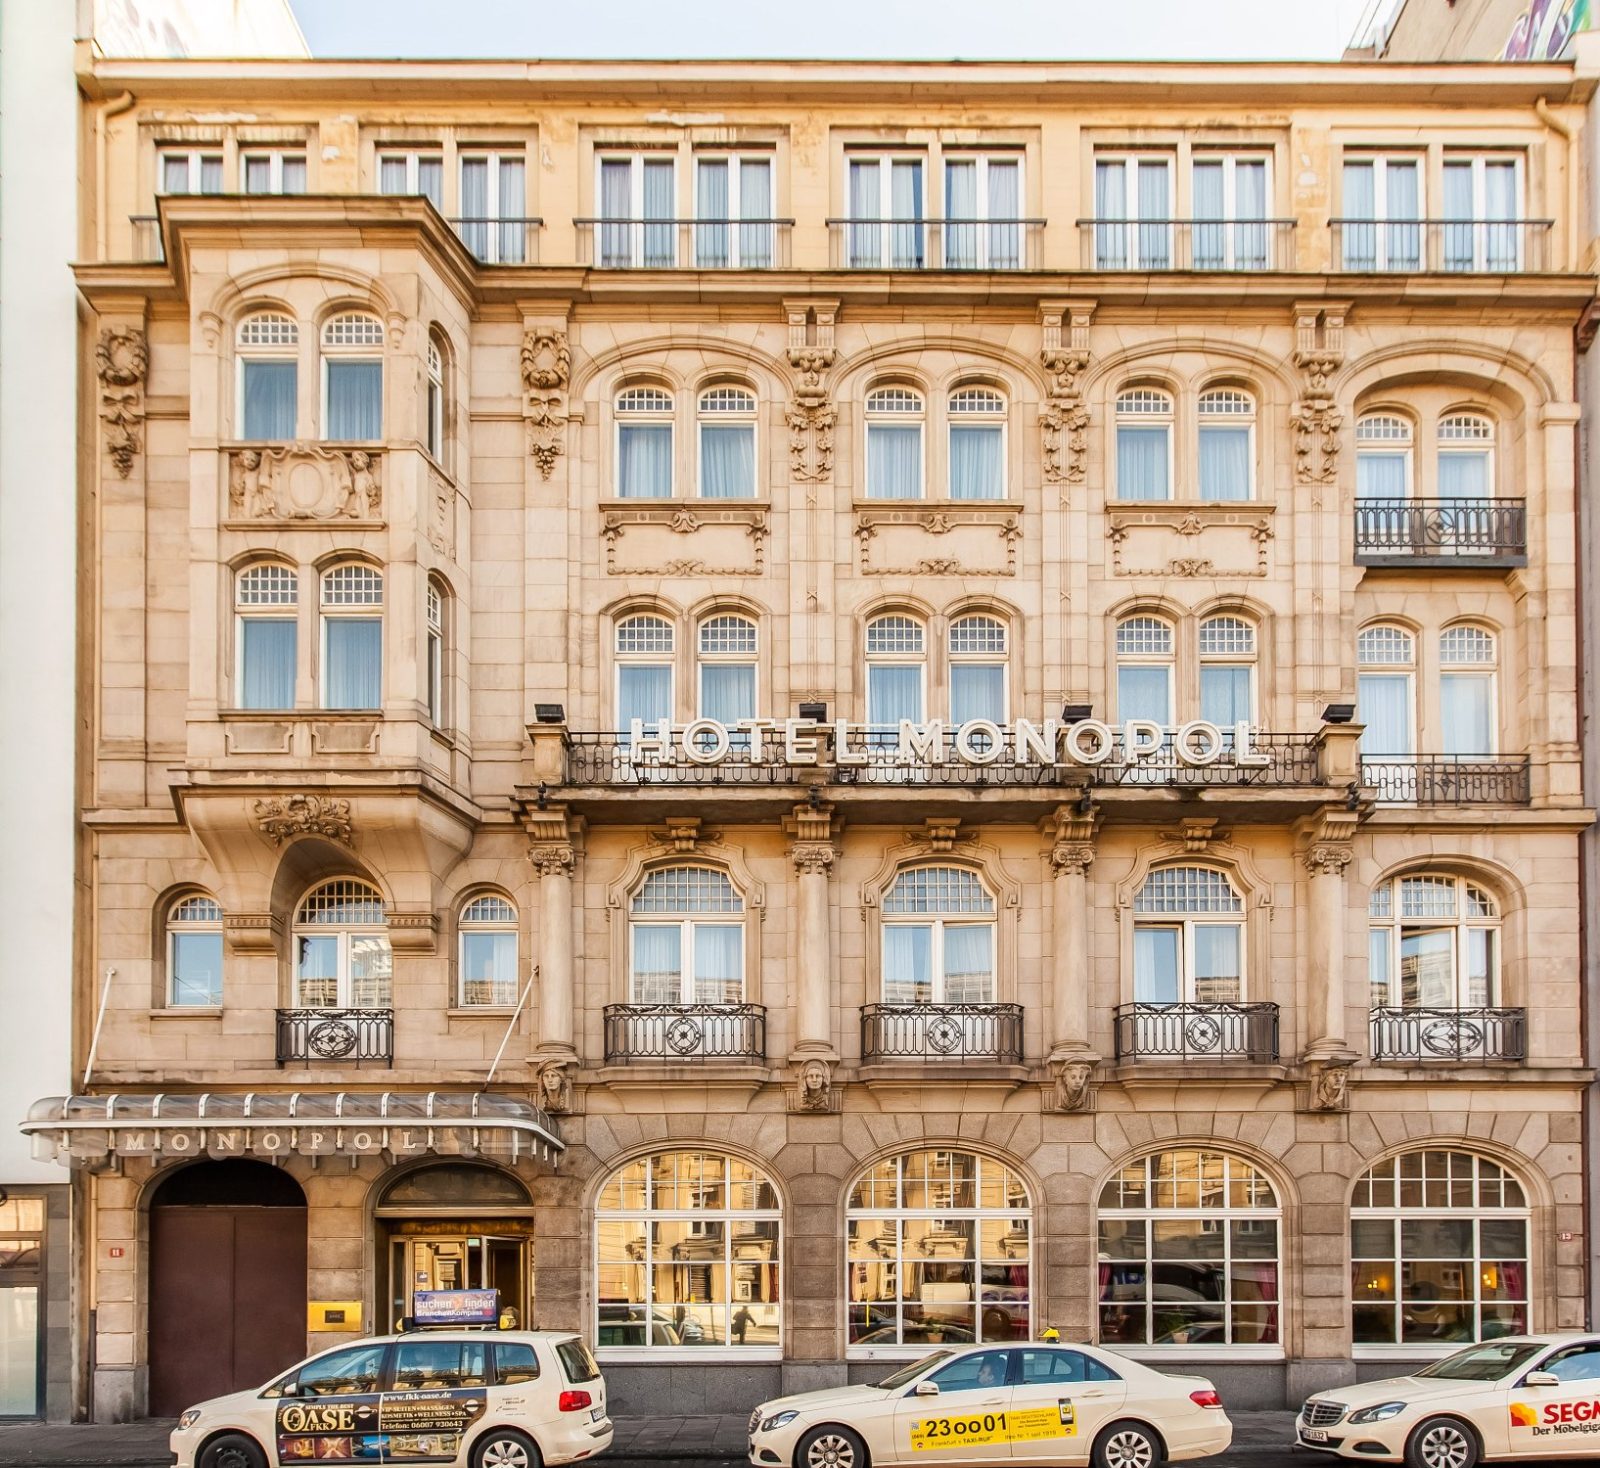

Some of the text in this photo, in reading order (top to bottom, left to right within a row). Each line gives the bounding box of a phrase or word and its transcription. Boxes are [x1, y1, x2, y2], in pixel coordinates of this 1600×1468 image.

[630, 717, 1271, 766] HOTEL MONOPOL
[125, 1132, 417, 1151] MONOPOL
[416, 1298, 495, 1309] suchen finden
[383, 1392, 452, 1401] www.fkk-oase.de
[282, 1404, 355, 1432] OASE
[310, 1423, 330, 1431] FKK
[382, 1422, 410, 1430] Telefon:
[1532, 1426, 1551, 1436] Der
